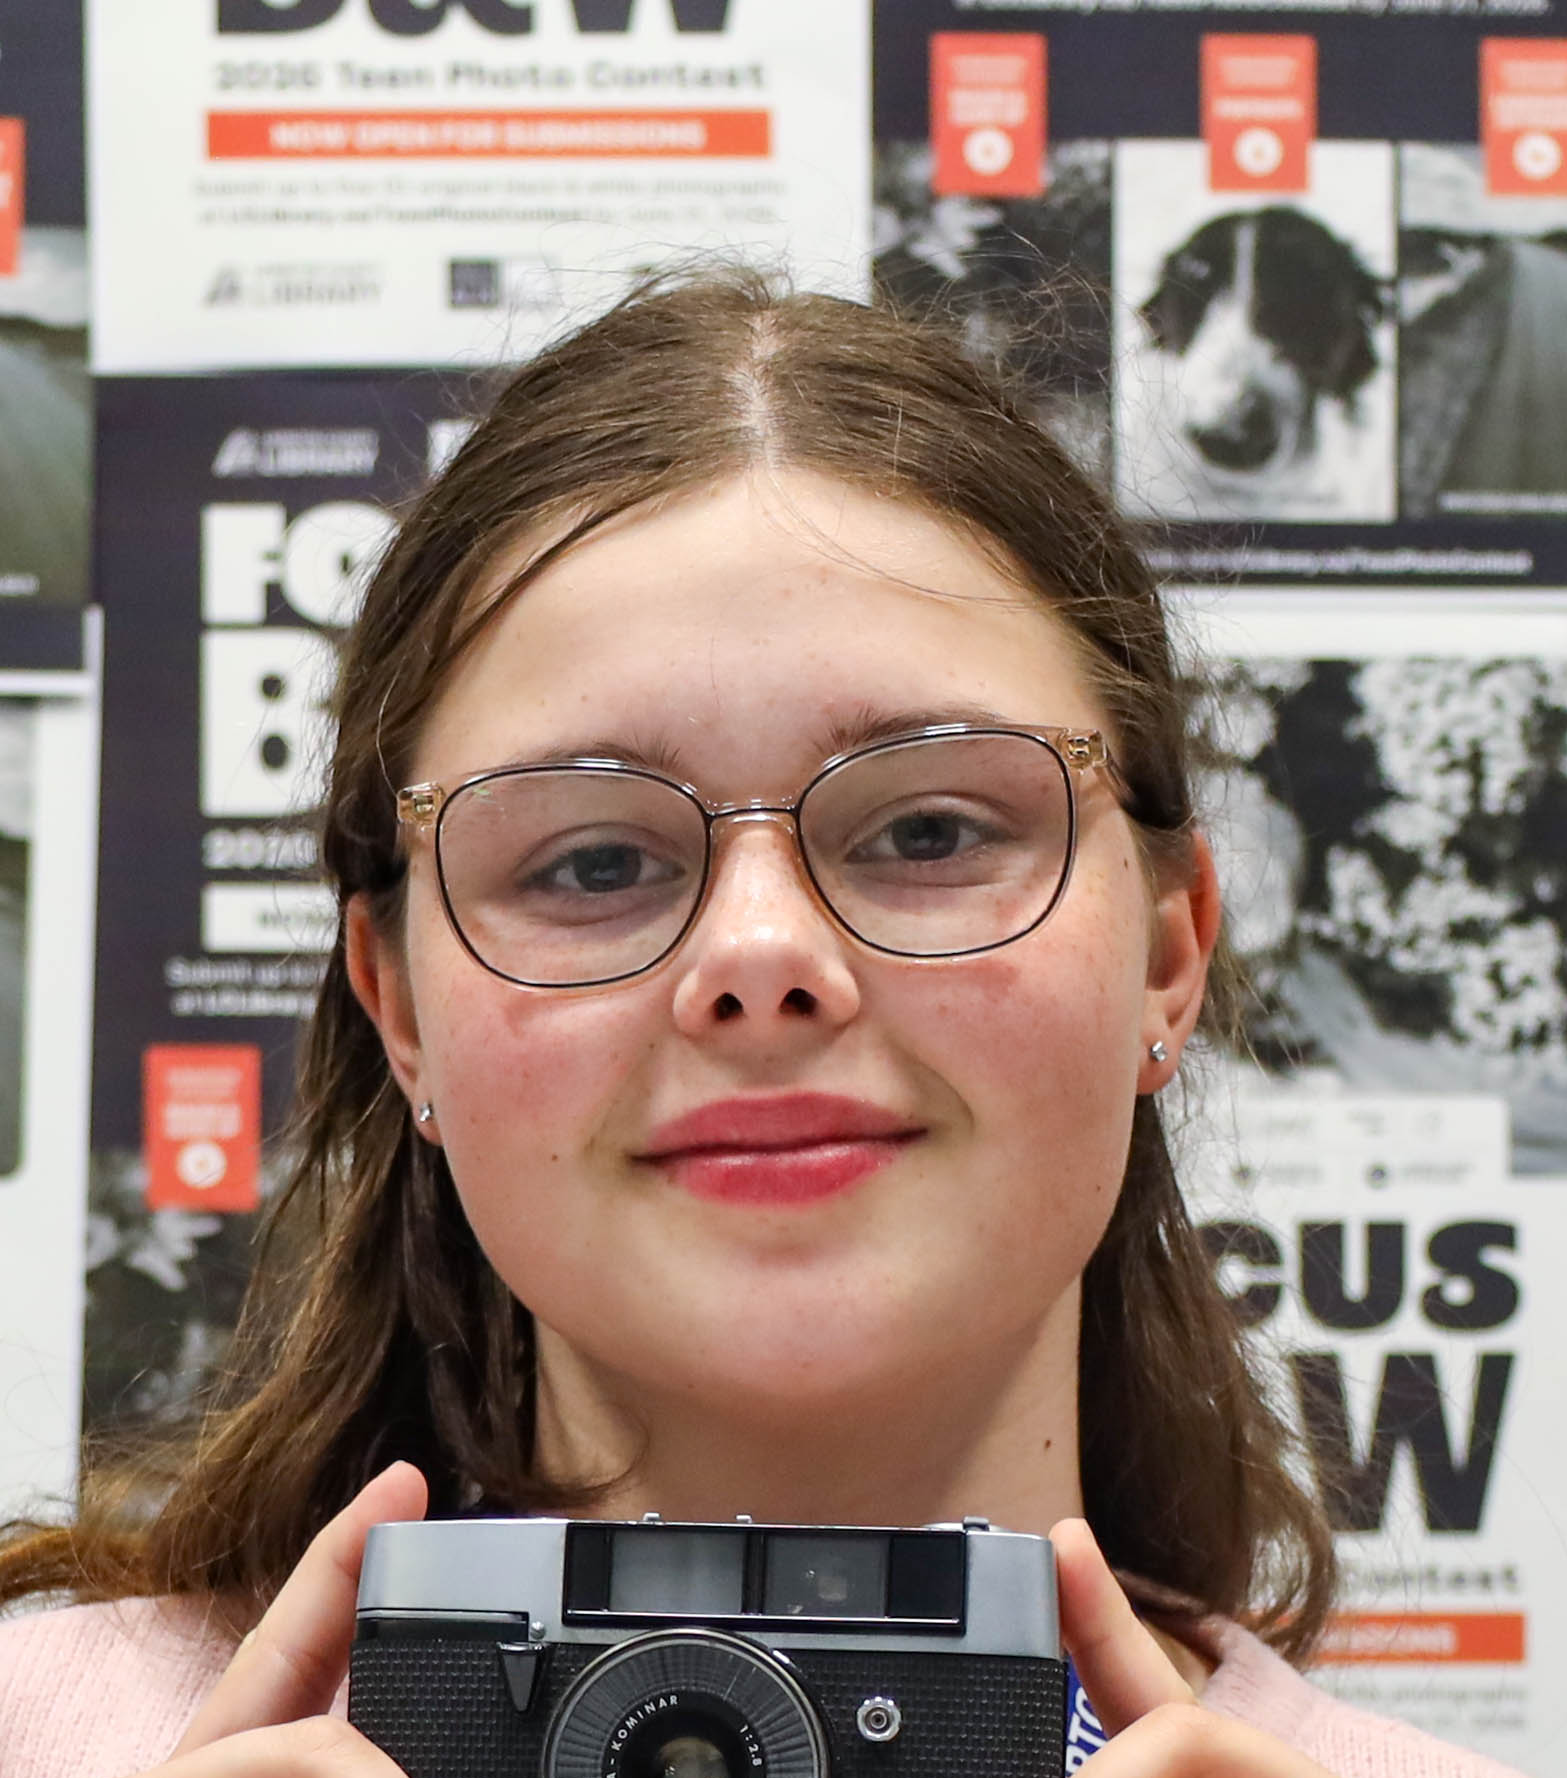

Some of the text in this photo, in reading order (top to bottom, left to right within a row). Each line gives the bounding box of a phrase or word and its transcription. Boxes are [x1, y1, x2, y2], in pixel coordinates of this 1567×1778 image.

[214, 60, 765, 91] 2026 Teen Photo Contest
[271, 120, 704, 149] NOW OPEN FOR SUBMISSIONS
[1198, 1219, 1519, 1332] CUS
[610, 1694, 679, 1752] KOMINAR
[739, 1723, 764, 1767] 1:2.8
